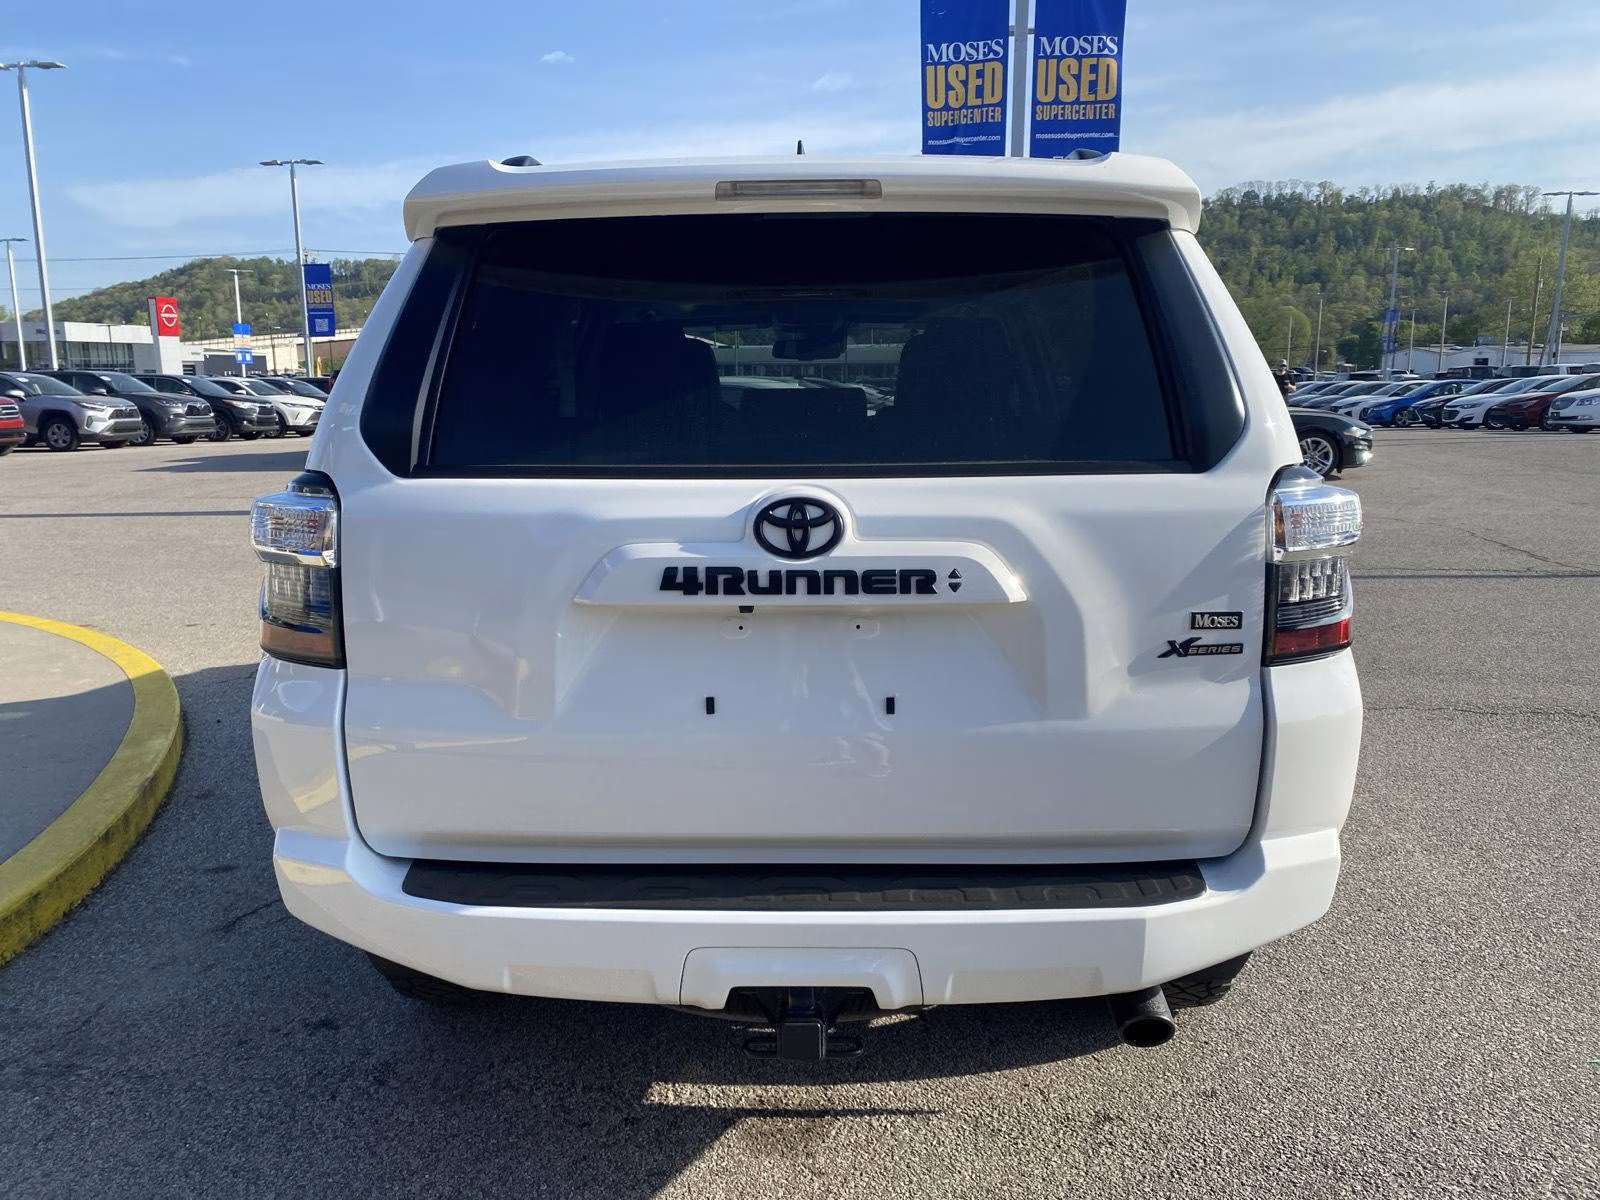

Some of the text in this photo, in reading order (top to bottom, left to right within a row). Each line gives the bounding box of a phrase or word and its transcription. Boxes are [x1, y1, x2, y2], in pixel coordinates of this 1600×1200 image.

[926, 39, 1004, 63] MOSES
[1039, 35, 1118, 56] MOSES
[926, 61, 1003, 109] USED
[1036, 57, 1118, 103] USED
[927, 107, 1002, 127] SUPERCENTER
[1035, 103, 1116, 121] SUPERCENTER
[307, 290, 332, 304] USED
[659, 566, 938, 596] 4RUNNER
